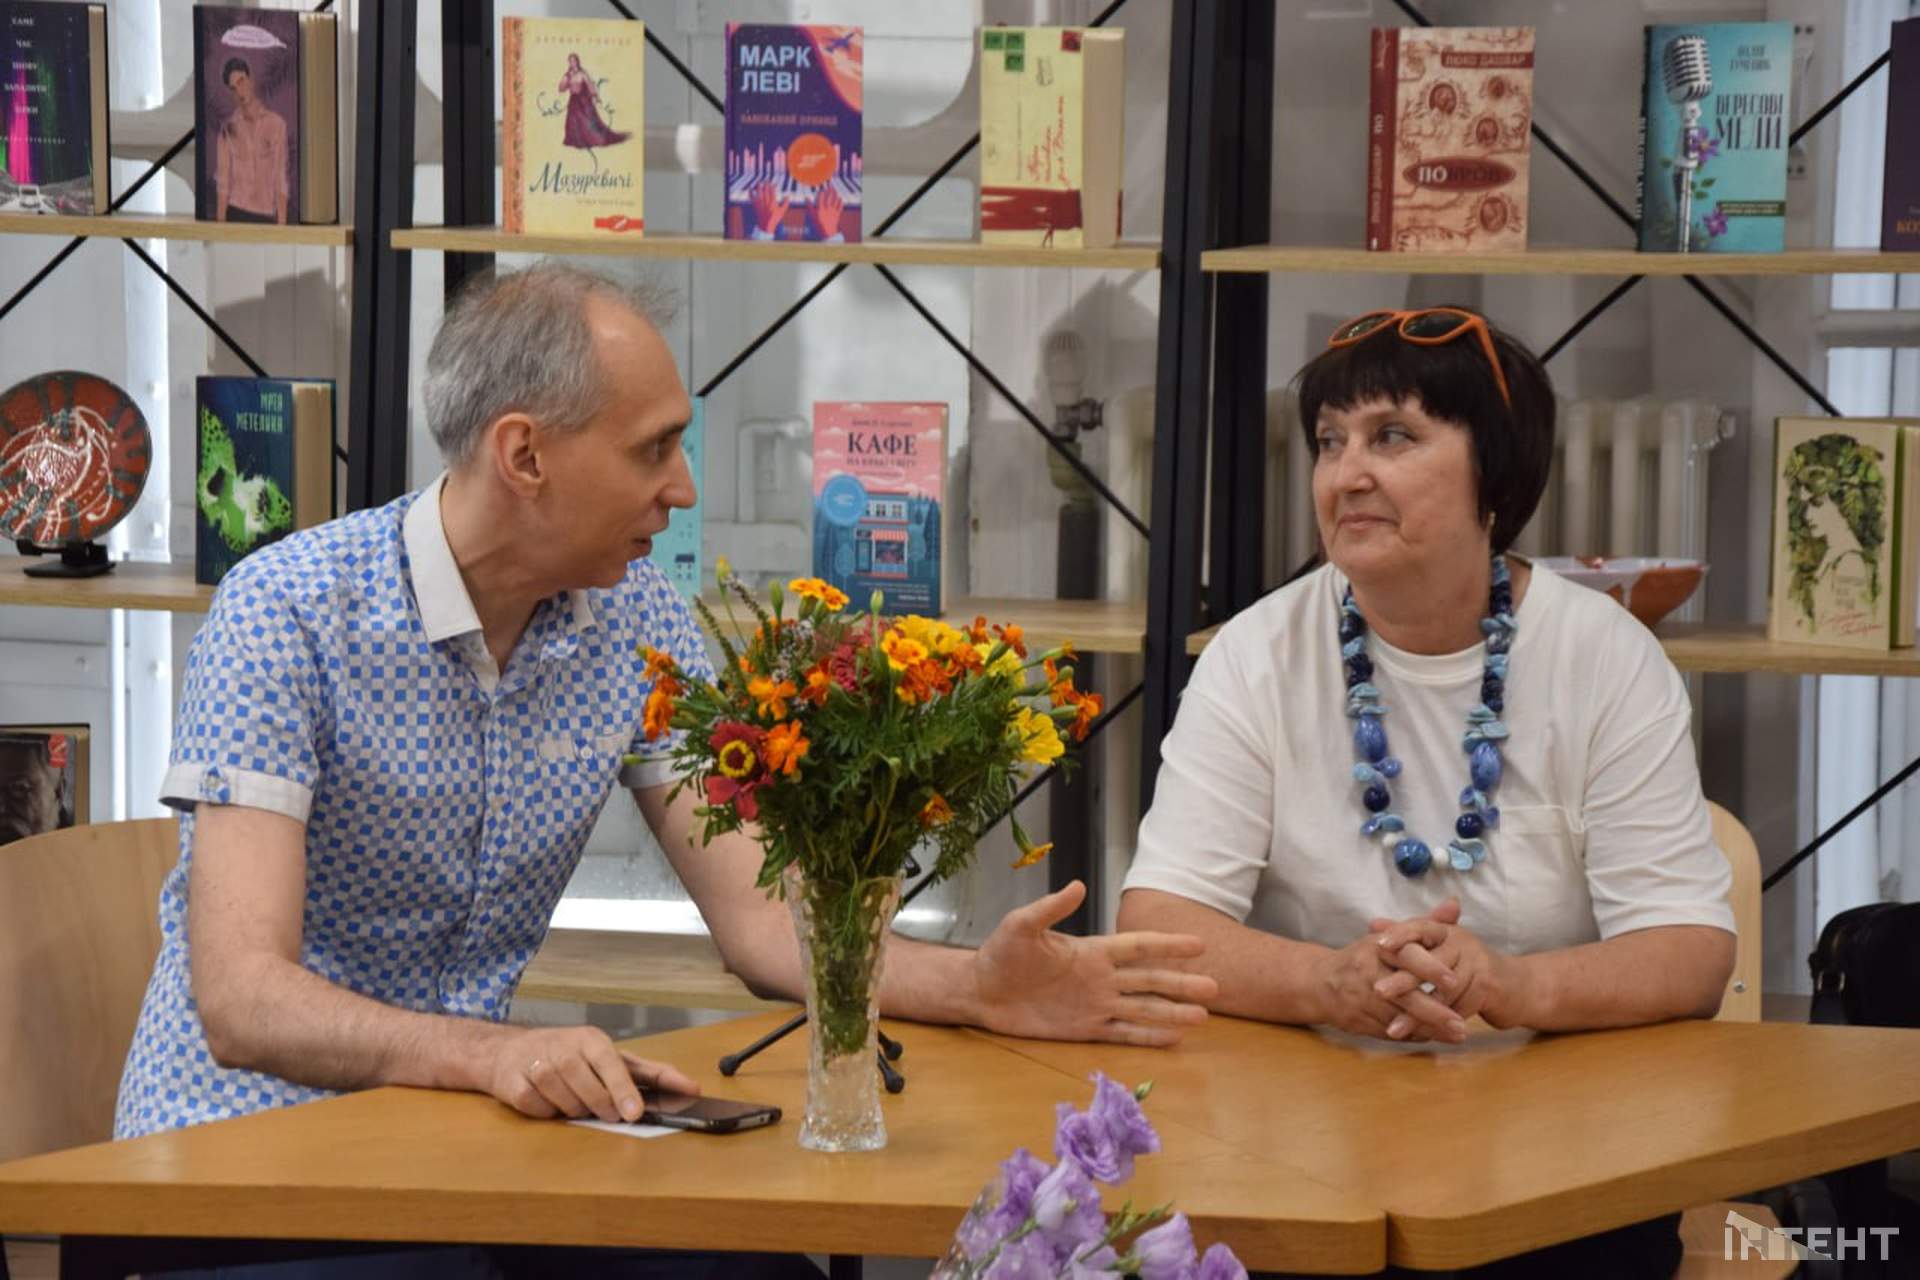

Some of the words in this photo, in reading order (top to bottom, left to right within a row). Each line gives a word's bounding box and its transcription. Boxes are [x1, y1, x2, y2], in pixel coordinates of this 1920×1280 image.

[740, 45, 812, 68] МАРК
[741, 70, 800, 93] ЛЕВІ
[528, 161, 634, 194] Мазуревичі
[847, 432, 918, 457] КАФЕ
